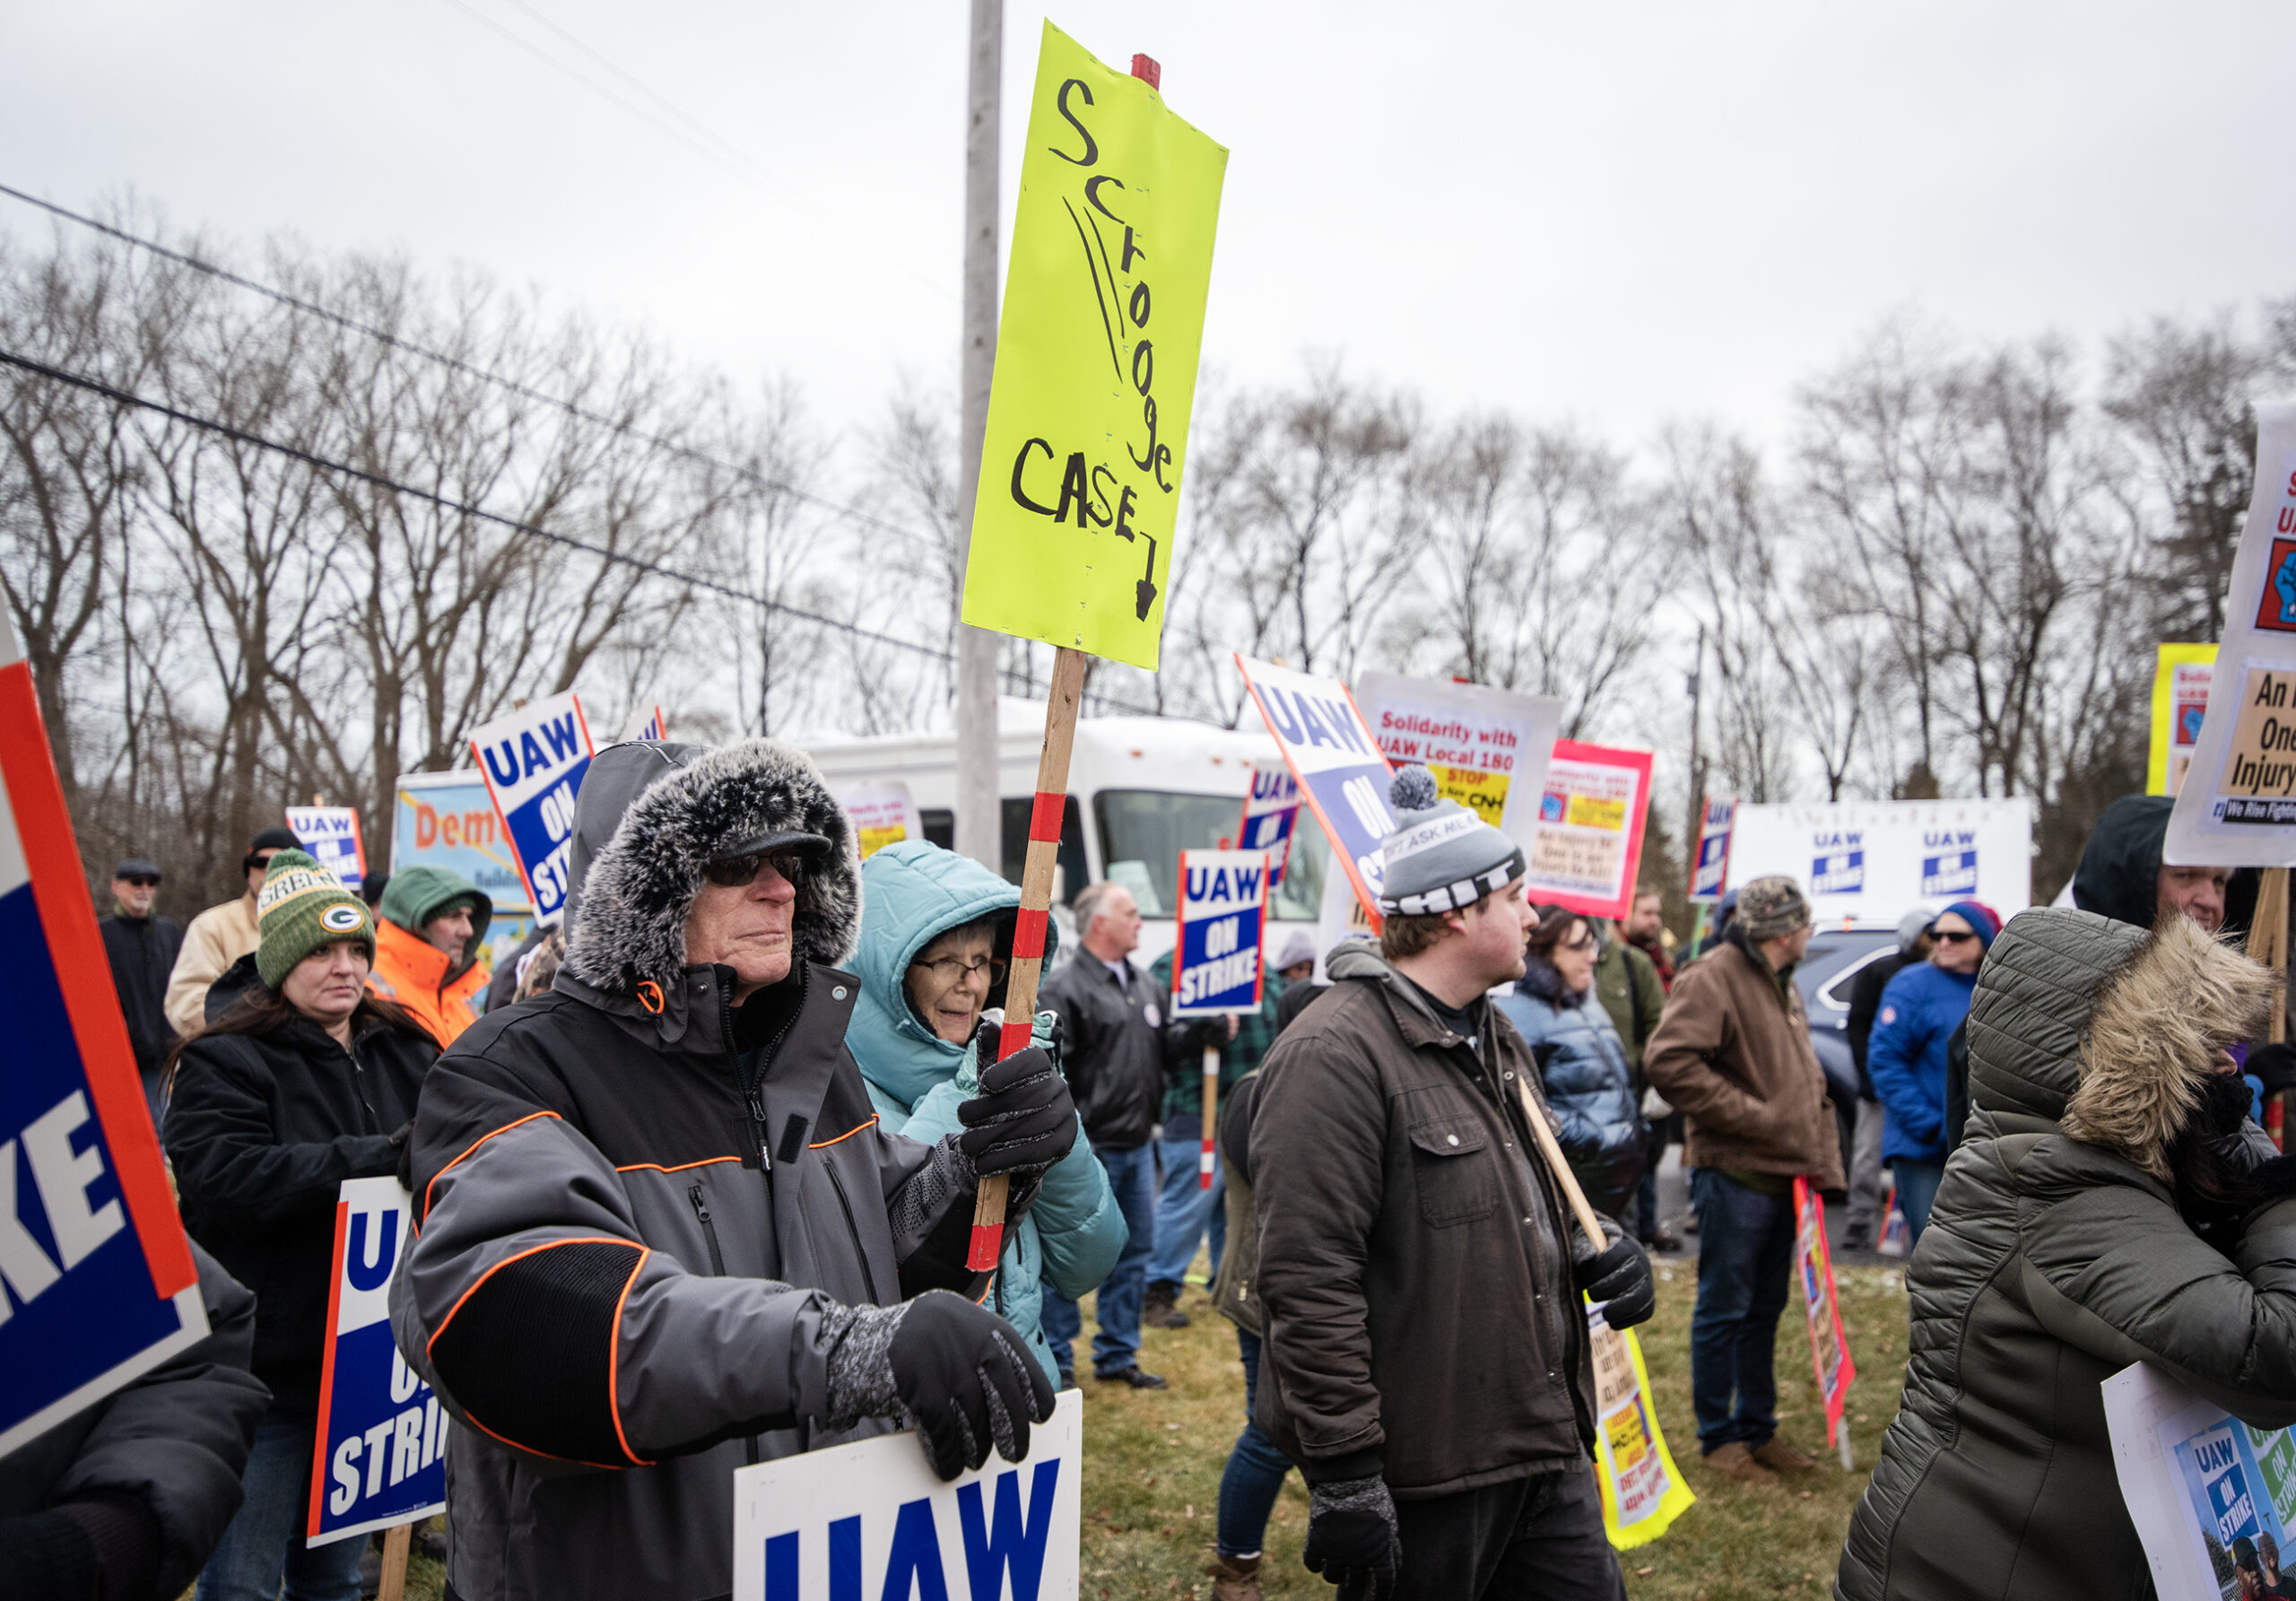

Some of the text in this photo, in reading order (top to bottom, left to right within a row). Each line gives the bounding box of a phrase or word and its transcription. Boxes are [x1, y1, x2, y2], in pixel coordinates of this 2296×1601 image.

[1048, 78, 1173, 494] Scrooge
[1010, 437, 1138, 544] CASE
[2255, 673, 2287, 708] An
[1254, 682, 1370, 756] UAW
[1381, 710, 1518, 749] Solidarity with
[483, 711, 578, 787] UAW
[1425, 743, 1475, 767] Local
[1480, 751, 1514, 772] 180
[1448, 768, 1490, 786] STOP
[293, 817, 350, 833] UAW
[540, 779, 576, 842] ON
[1342, 773, 1401, 840] ON
[2228, 801, 2245, 817] We
[1408, 826, 1441, 849] ASK
[1814, 831, 1864, 847] UAW
[1924, 831, 1975, 847] UAW
[1187, 867, 1264, 902] UAW
[1205, 916, 1239, 959] ON
[1179, 945, 1258, 1005] STRIKE
[0, 1088, 126, 1329] KE
[329, 1396, 450, 1518] STRI
[2196, 1437, 2235, 1473] UAW
[2272, 1443, 2288, 1483] ON
[2220, 1475, 2237, 1508] ON
[2219, 1492, 2253, 1543] STRIKE
